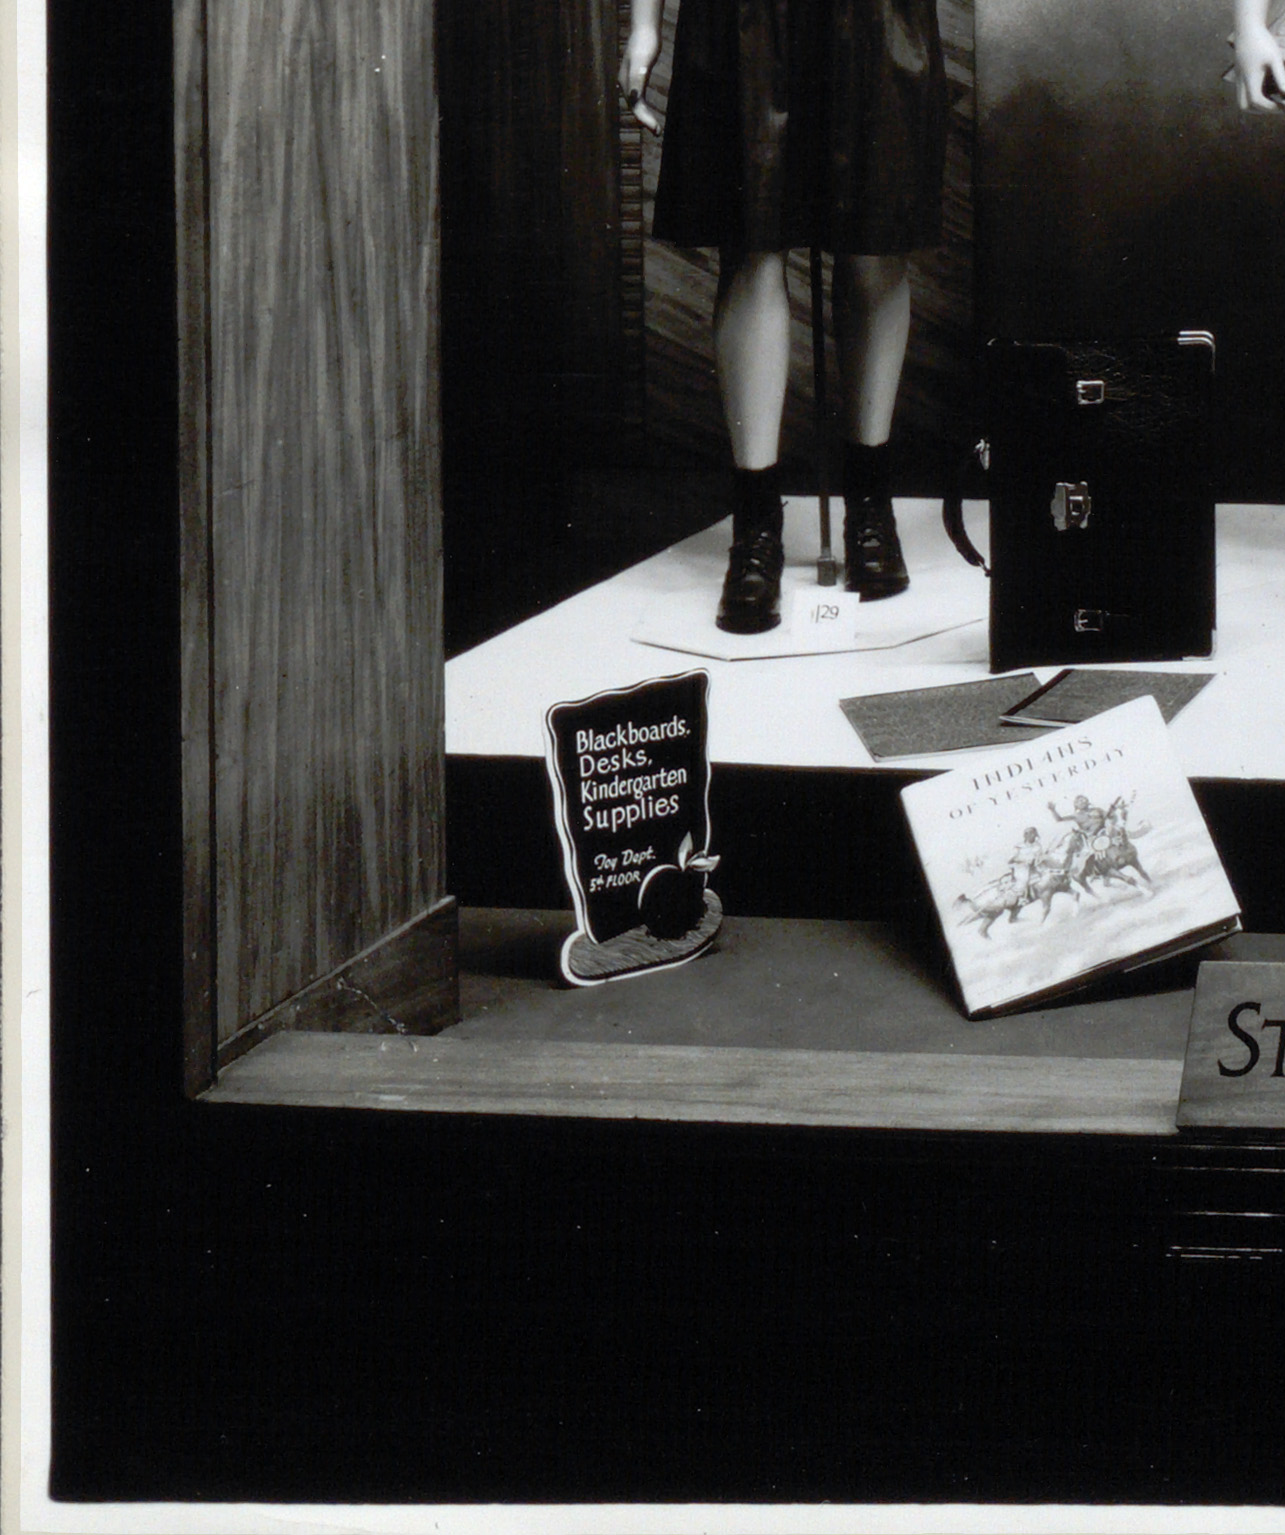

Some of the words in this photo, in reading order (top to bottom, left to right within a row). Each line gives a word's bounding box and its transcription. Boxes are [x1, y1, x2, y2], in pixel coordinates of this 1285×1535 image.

[579, 747, 653, 778] Desks,
[971, 735, 1093, 791] INDIANS
[580, 767, 688, 804] Kindergarten
[583, 794, 680, 834] Supplies
[593, 853, 618, 872] Toy
[621, 845, 657, 866] Dept.
[605, 870, 641, 889] FLOOR
